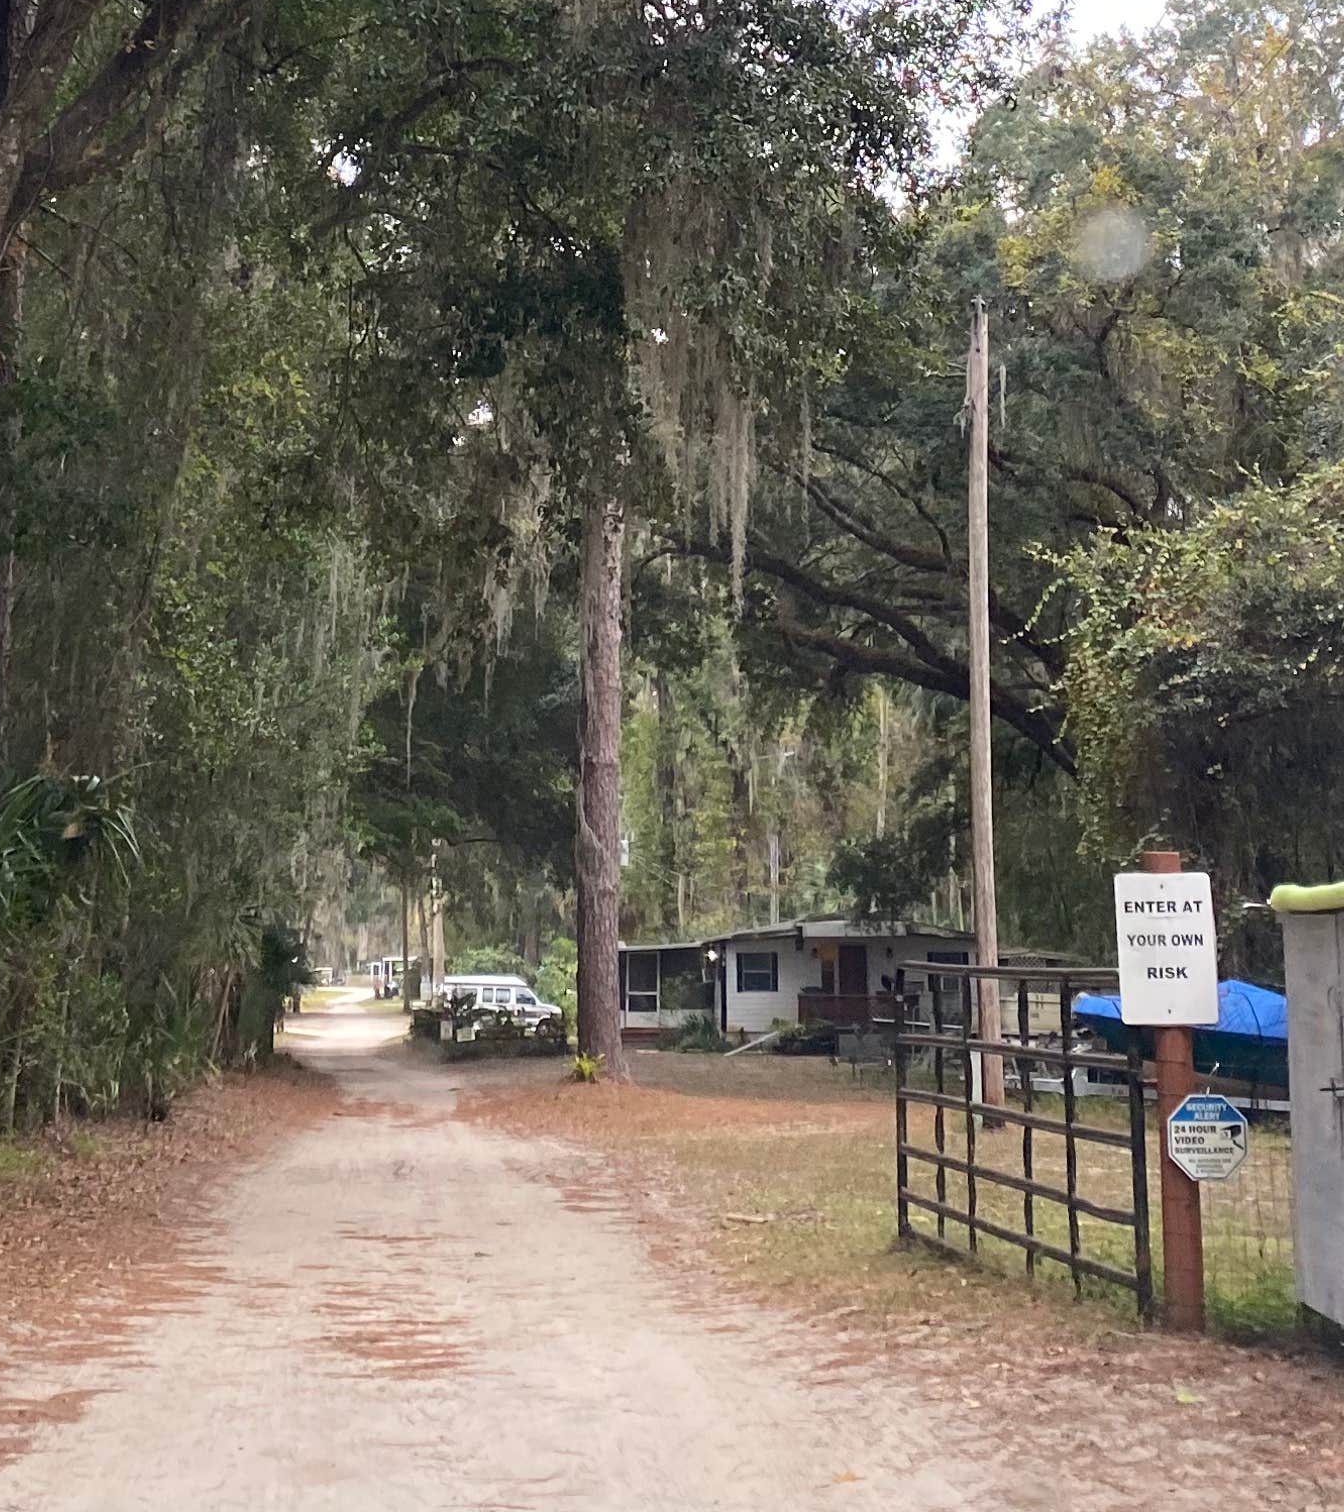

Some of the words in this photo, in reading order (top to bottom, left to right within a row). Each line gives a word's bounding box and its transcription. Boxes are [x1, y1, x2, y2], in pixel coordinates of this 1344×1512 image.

[1124, 900, 1177, 913] ENTER
[1182, 900, 1203, 913] AT
[1127, 934, 1167, 947] YOUR
[1171, 933, 1204, 947] OWN
[1147, 967, 1189, 979] RISK
[1186, 1102, 1227, 1113] SECURITY
[1194, 1112, 1220, 1121] ALERT
[1174, 1126, 1186, 1134] 24
[1189, 1126, 1217, 1134] HOUR
[1175, 1136, 1205, 1145] VIDEO
[1175, 1147, 1234, 1155] SURVEILLANCE
